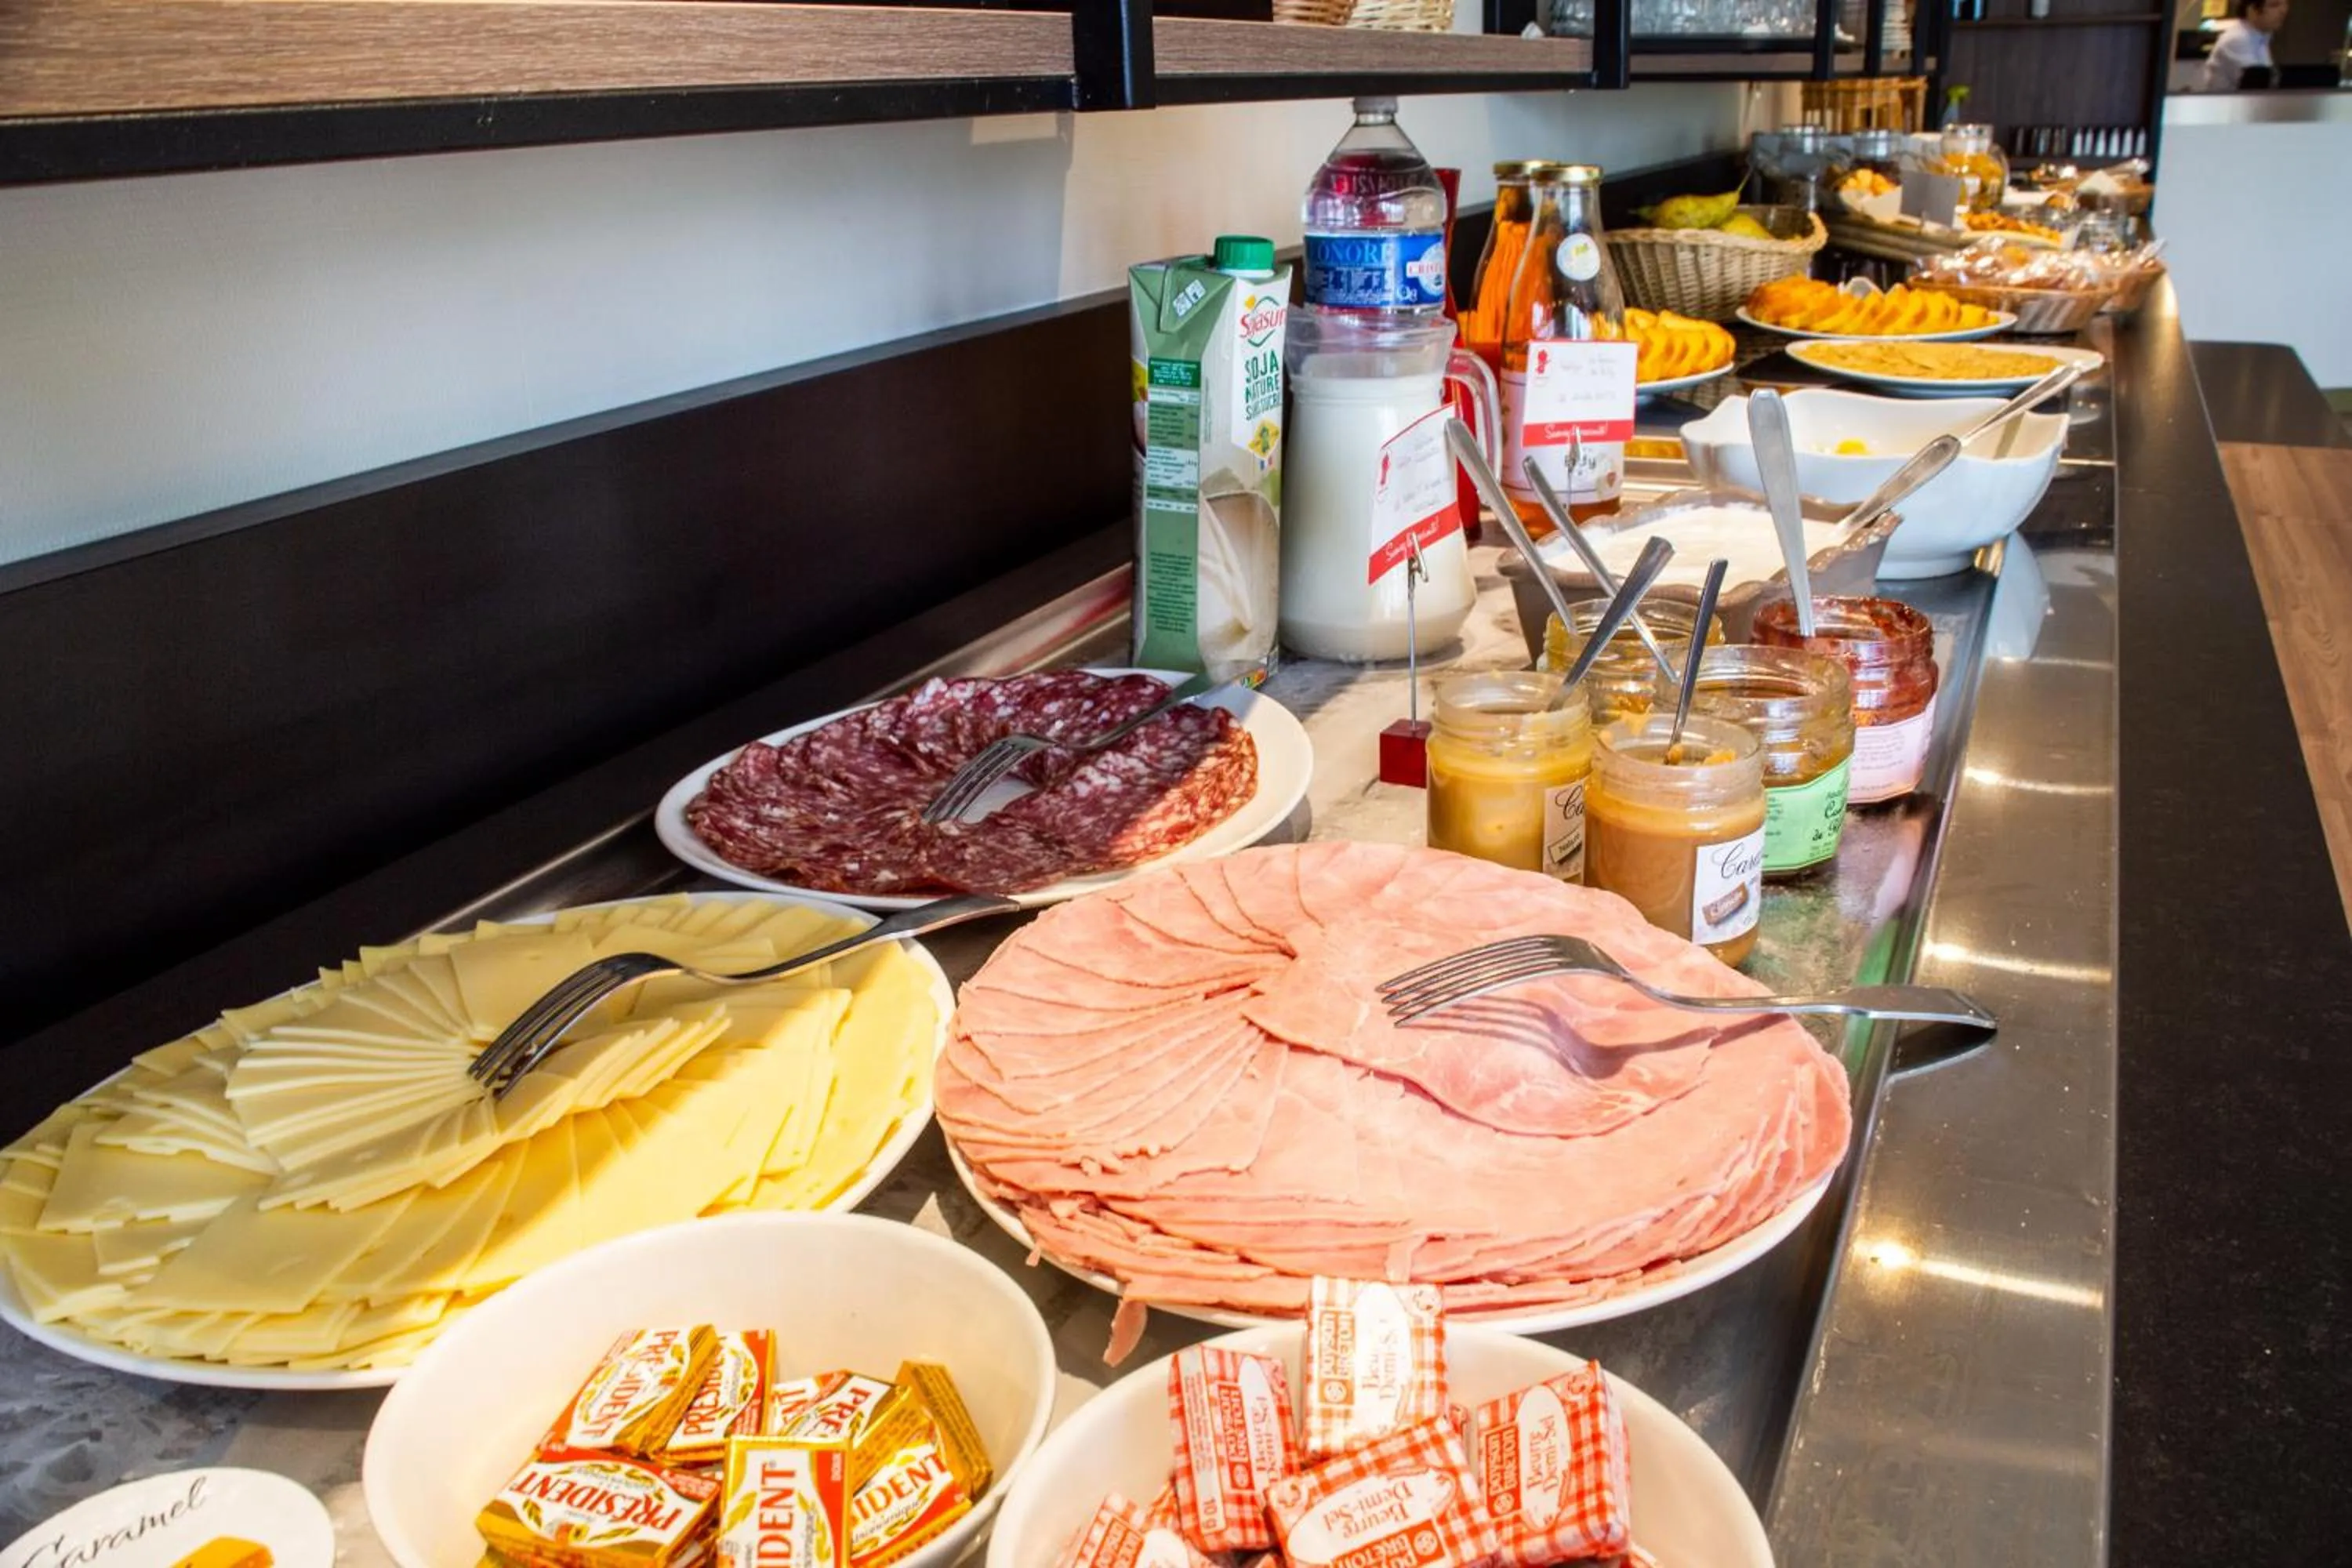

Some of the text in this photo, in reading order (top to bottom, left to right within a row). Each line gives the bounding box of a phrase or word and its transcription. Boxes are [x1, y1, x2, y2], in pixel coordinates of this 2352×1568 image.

[1244, 349, 1279, 383] SOJA
[1244, 372, 1279, 404] NATURE
[1526, 1430, 1544, 1489] Beurre
[1540, 1414, 1559, 1494] Demi-Sel
[513, 1471, 683, 1532] PRÉSIDENT
[1203, 1498, 1218, 1515] 10
[1323, 1480, 1414, 1531] Demi-Sel
[1342, 1501, 1409, 1539] Beurre
